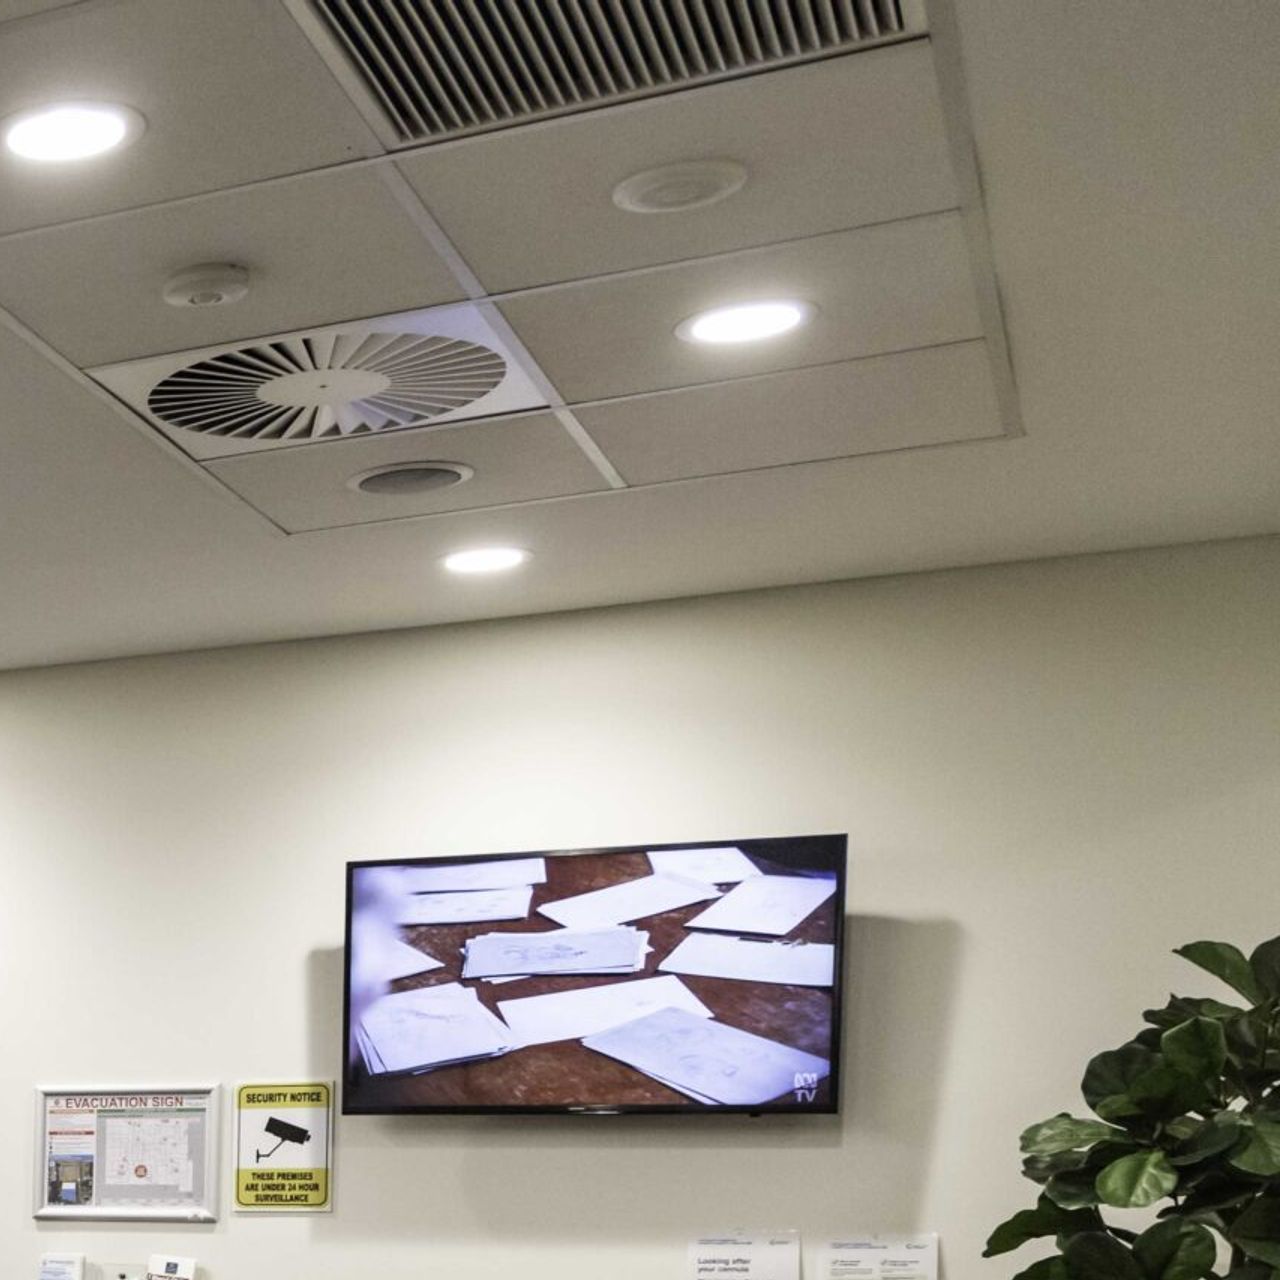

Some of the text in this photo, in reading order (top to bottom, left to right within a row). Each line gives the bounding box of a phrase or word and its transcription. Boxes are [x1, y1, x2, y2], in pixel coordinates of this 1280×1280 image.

[246, 1091, 322, 1103] SECURITY NOTICE
[793, 1089, 817, 1102] TV
[65, 1096, 184, 1109] EVACUATION SIGN
[251, 1172, 313, 1180] THESE PREMISES
[245, 1183, 320, 1191] ARE UNDER 24 HOUR
[255, 1194, 309, 1203] SURVEILLANCE
